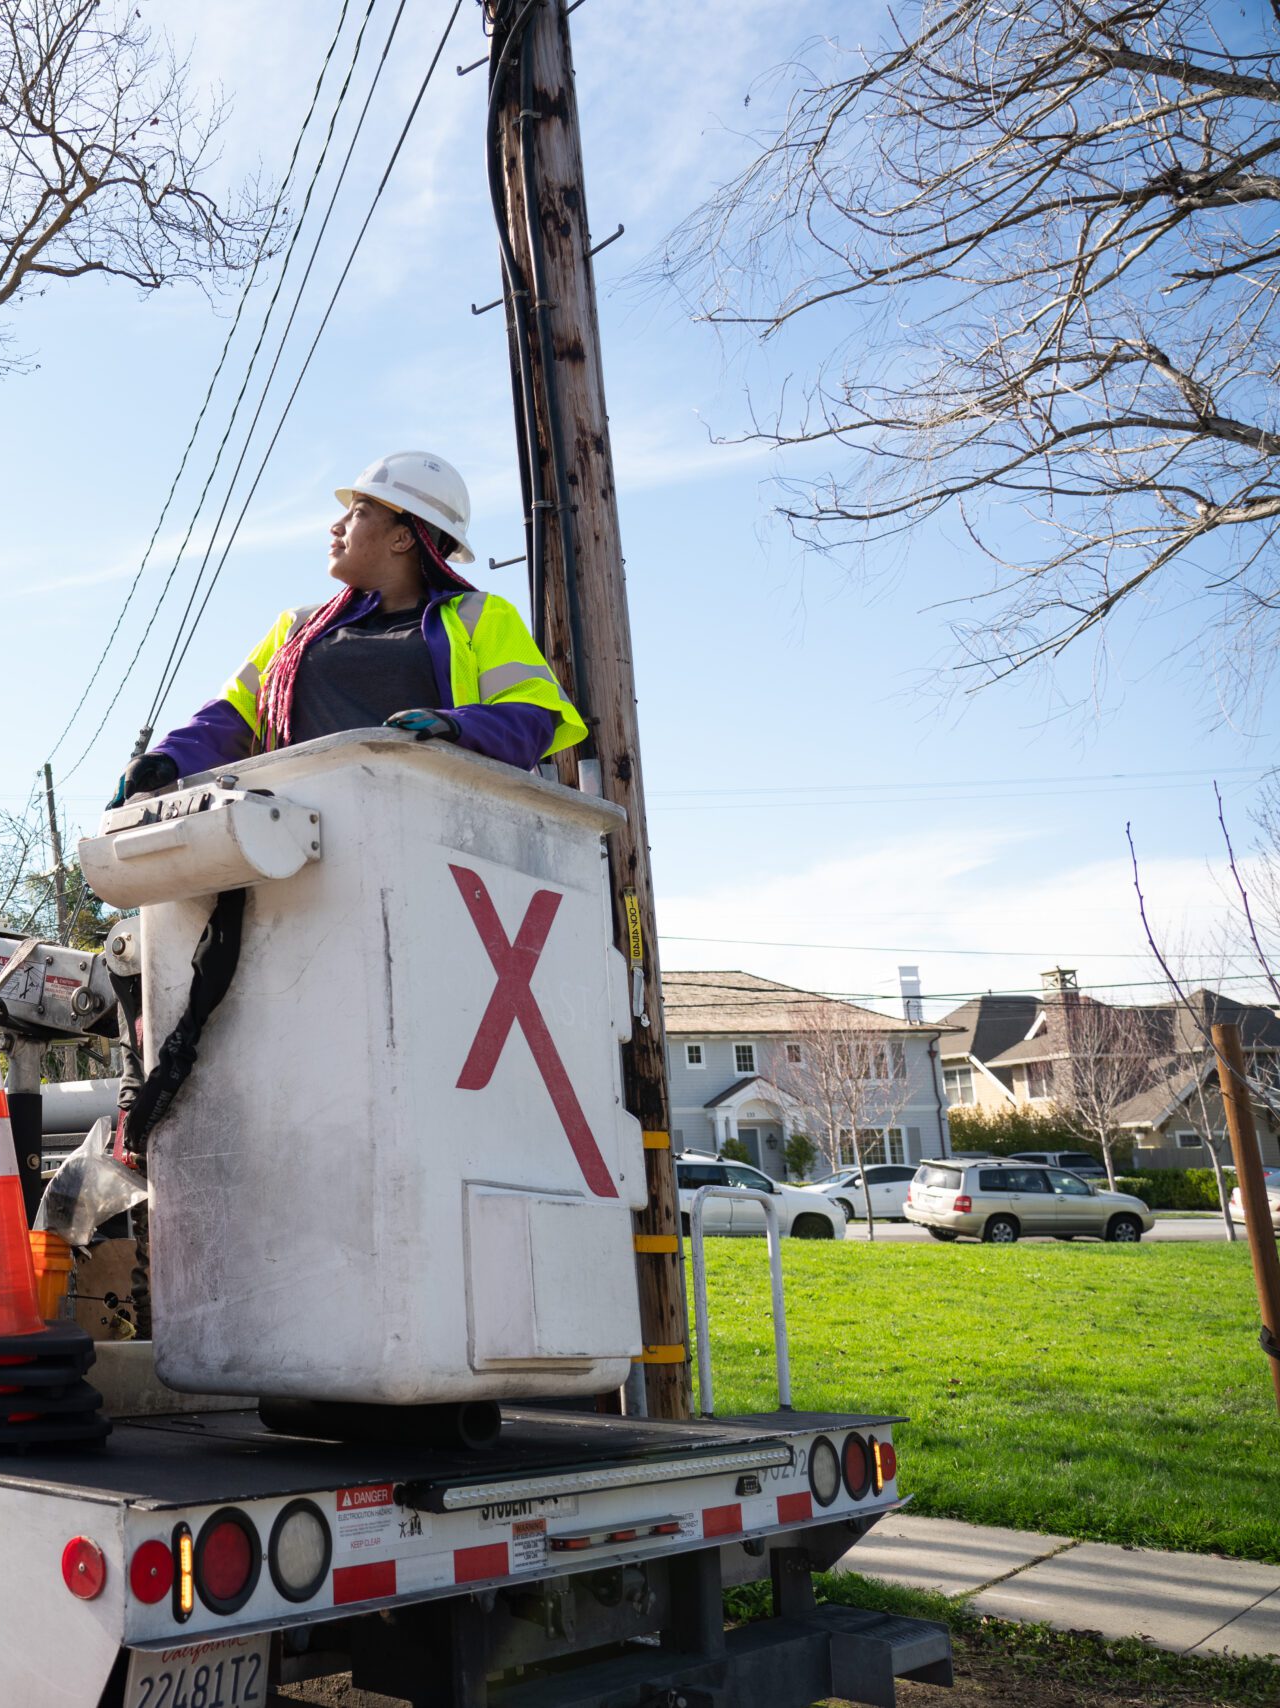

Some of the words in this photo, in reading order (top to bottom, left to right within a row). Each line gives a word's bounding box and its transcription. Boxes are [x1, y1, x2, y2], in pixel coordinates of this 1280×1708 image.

[354, 1489, 388, 1505] DANGER
[351, 1540, 365, 1550] KEEP
[365, 1538, 381, 1547] CLEAR
[137, 1652, 262, 1708] 22481T2
